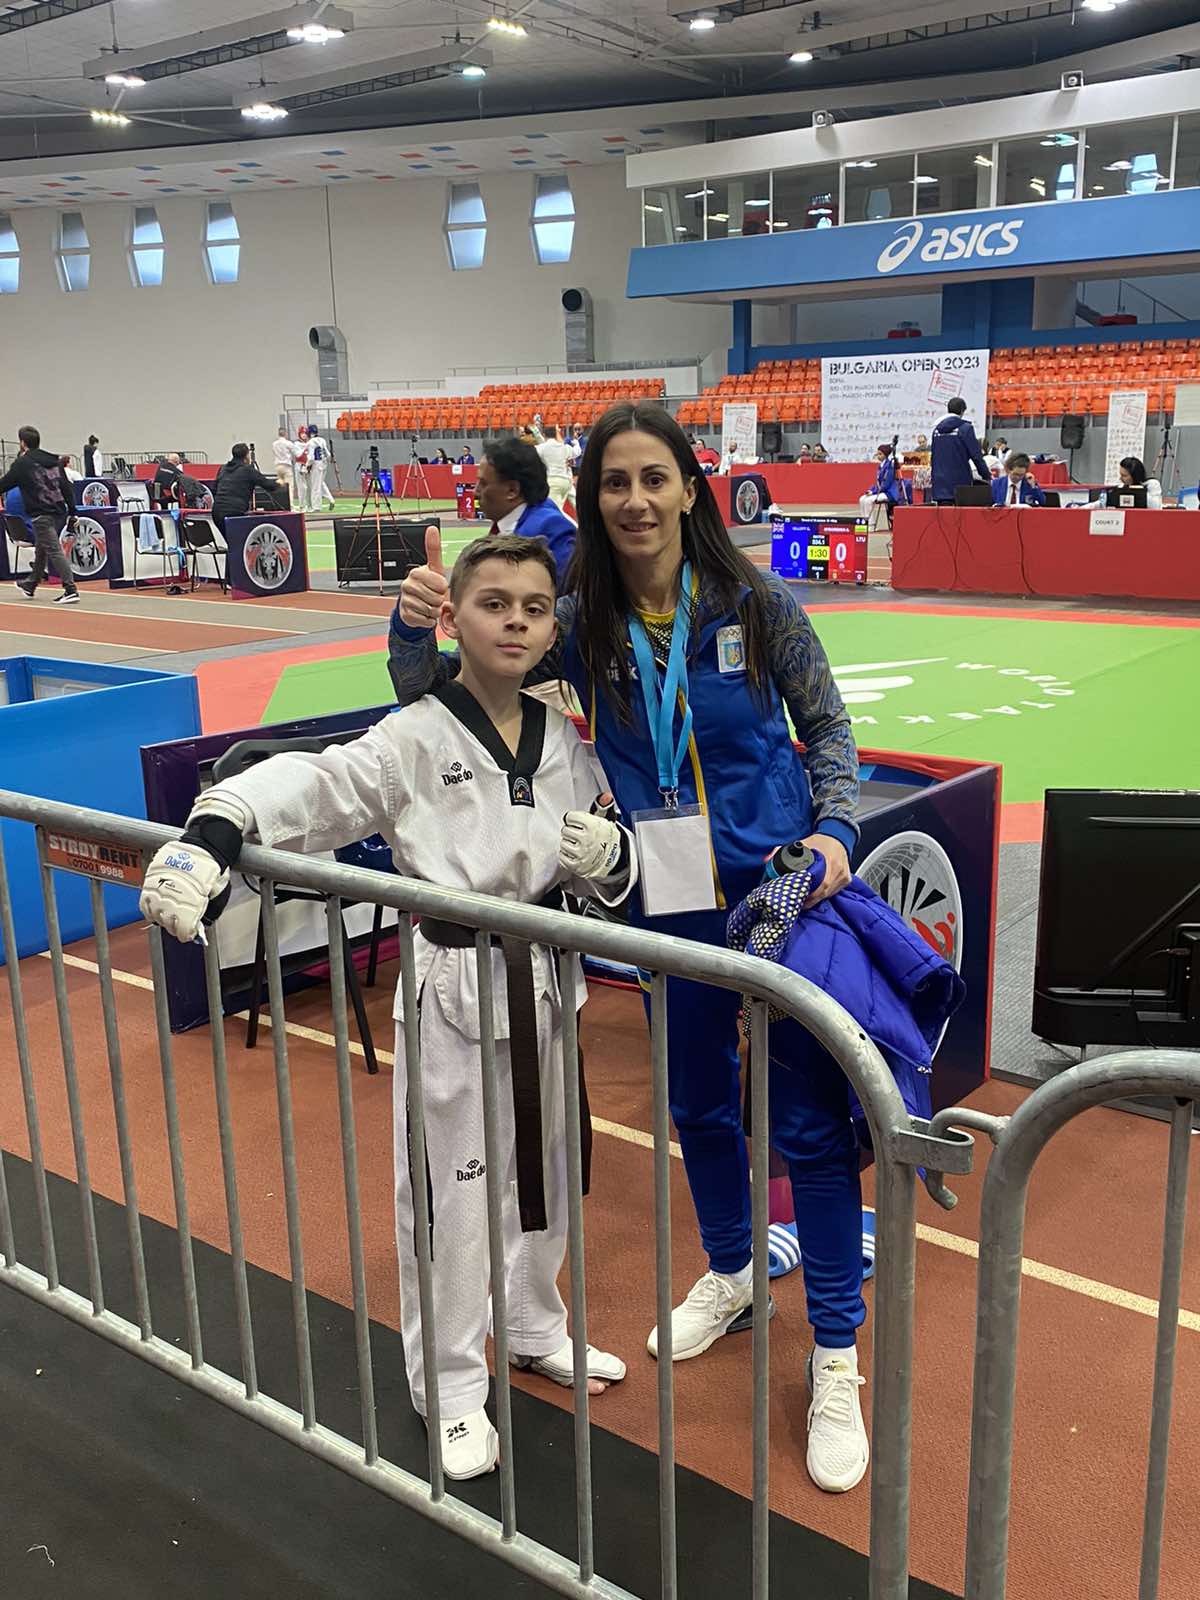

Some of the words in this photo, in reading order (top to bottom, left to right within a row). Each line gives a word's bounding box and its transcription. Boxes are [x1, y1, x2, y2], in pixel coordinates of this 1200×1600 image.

[829, 361, 898, 375] BULGARIA
[902, 358, 940, 371] OPEN
[944, 356, 980, 369] 2023
[789, 541, 801, 561] 0
[809, 549, 828, 558] 1:30
[835, 542, 847, 562] 0
[441, 769, 473, 787] Daedo
[164, 855, 194, 872] Daedo
